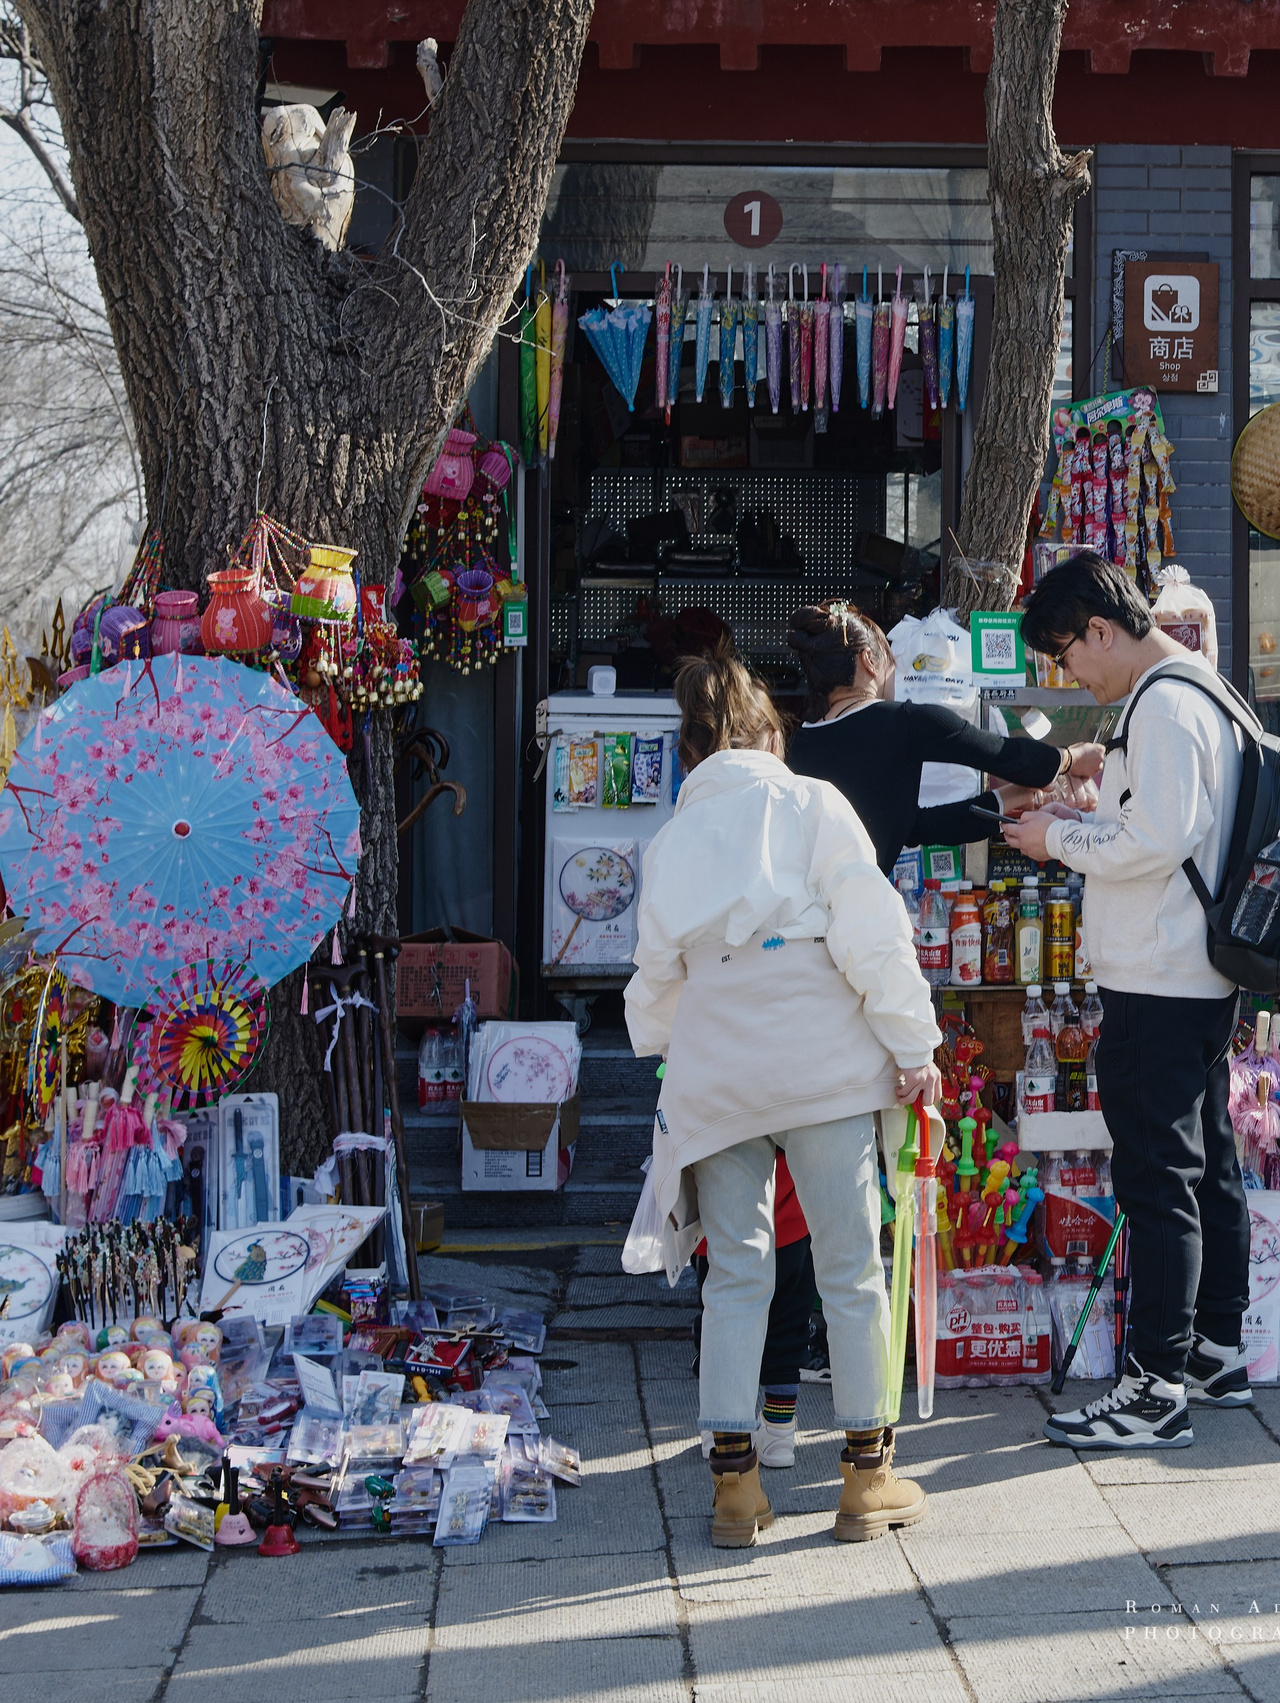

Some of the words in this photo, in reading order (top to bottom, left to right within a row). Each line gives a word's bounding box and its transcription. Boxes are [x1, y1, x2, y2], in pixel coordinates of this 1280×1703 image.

[743, 201, 761, 236] 1
[1149, 336, 1194, 360] 商店
[1159, 361, 1181, 371] Shop
[1161, 373, 1179, 382] 상점
[1086, 395, 1125, 428] 阿尔卑斯
[1059, 1213, 1096, 1228] 娃哈哈
[949, 1312, 967, 1330] pH
[969, 1340, 1021, 1358] 更优惠
